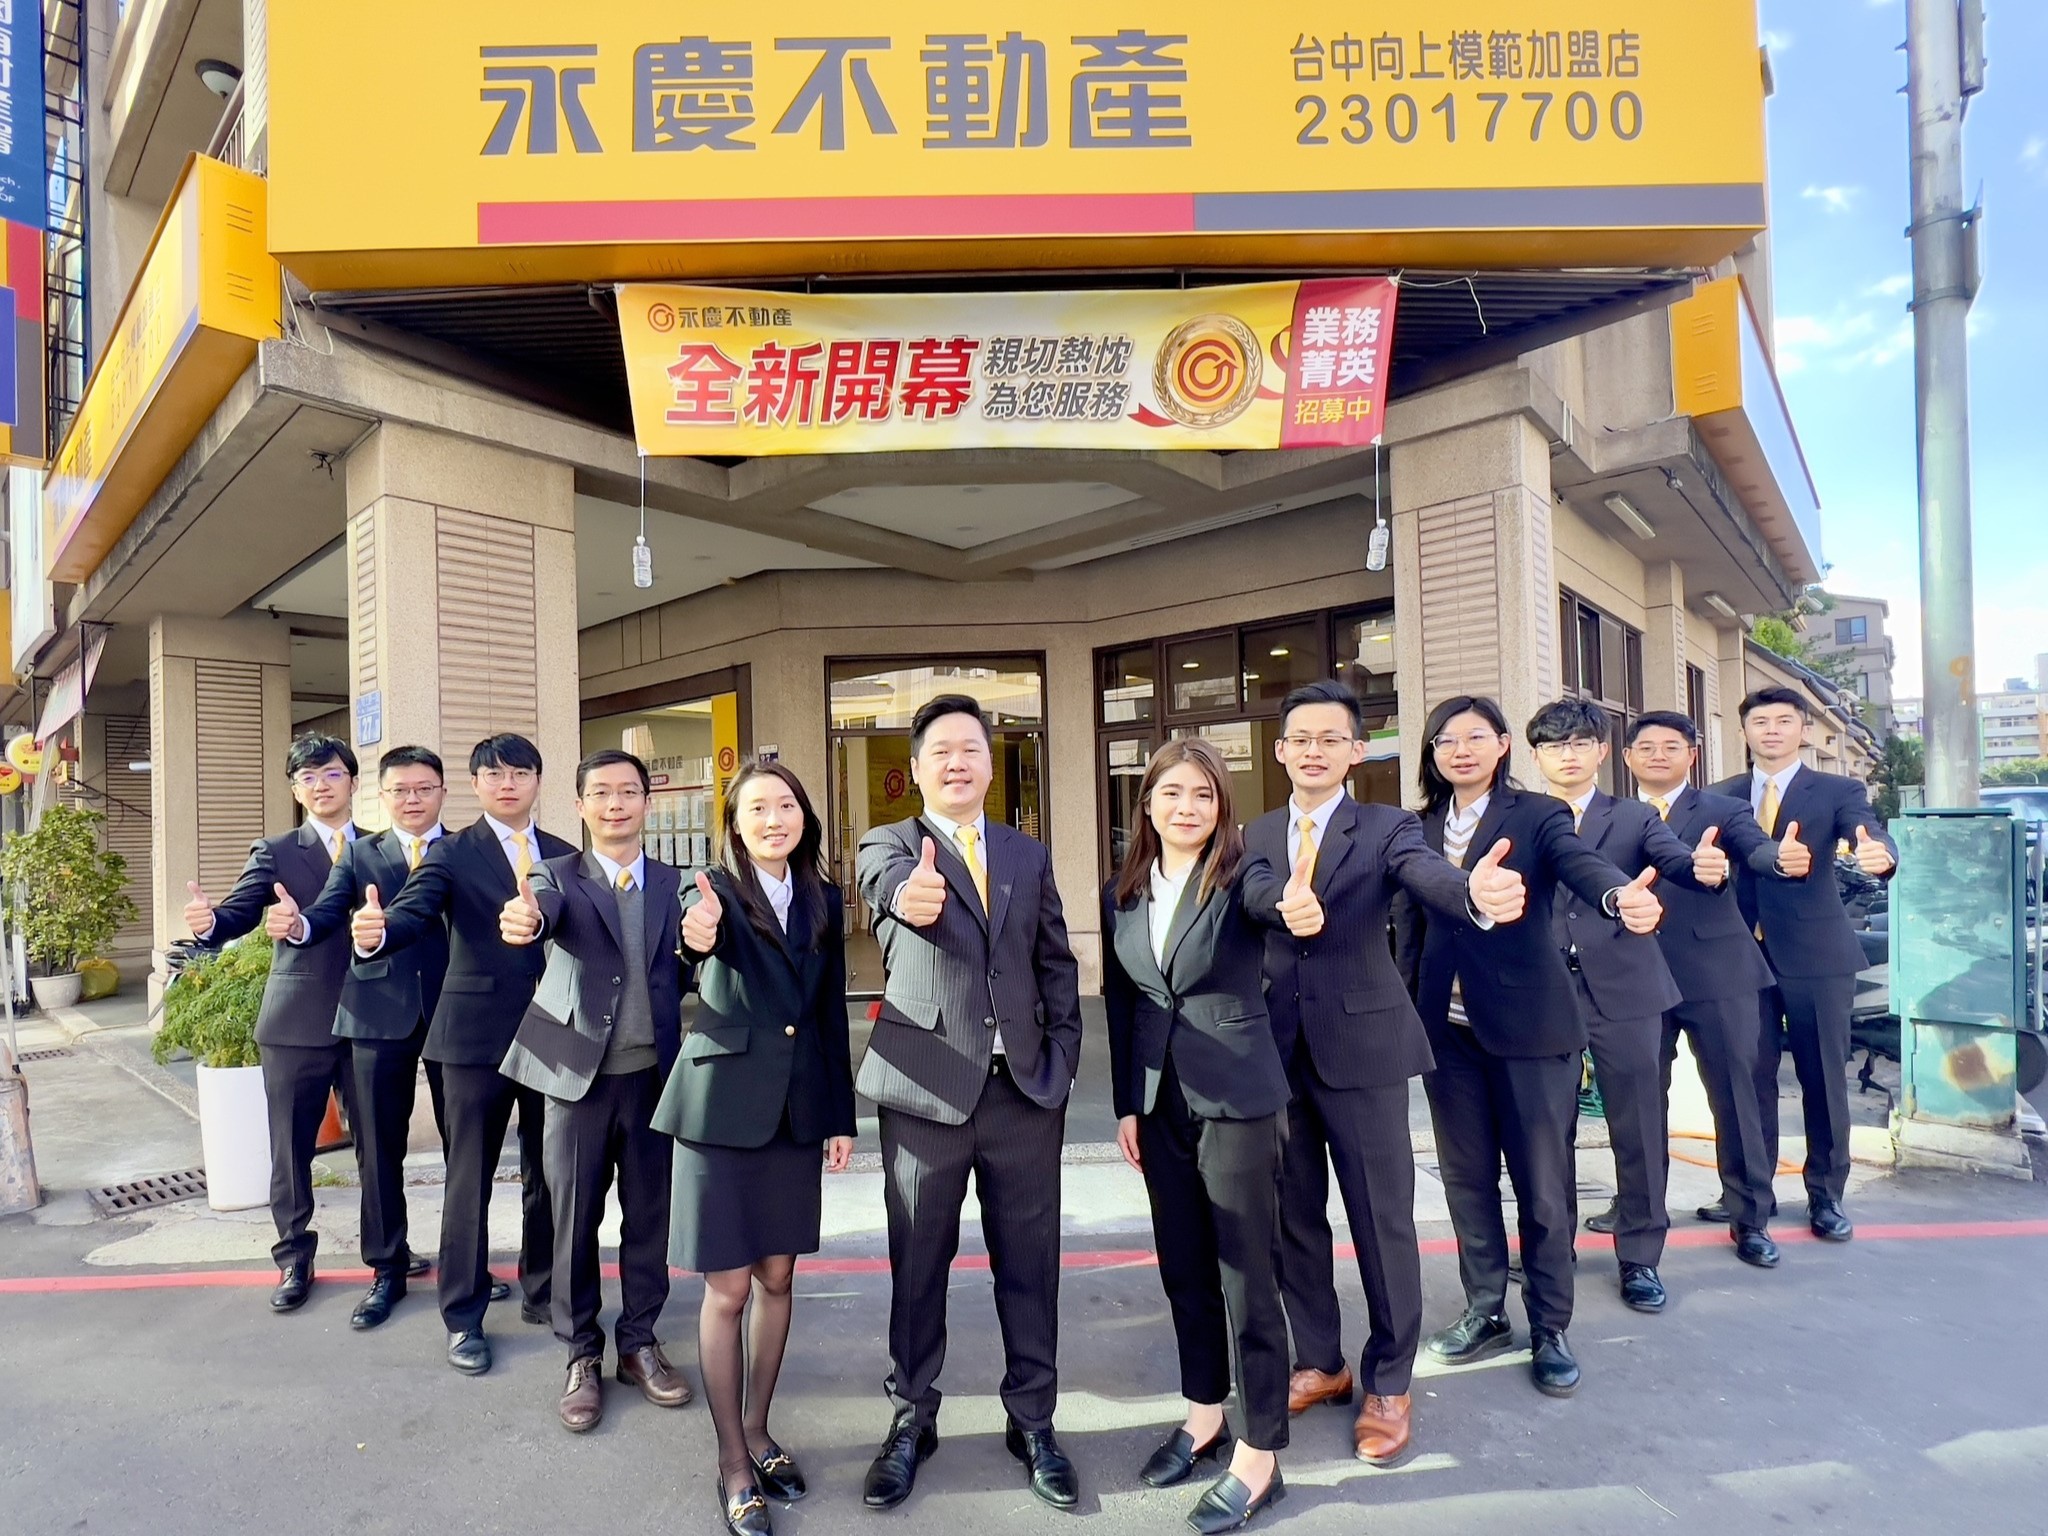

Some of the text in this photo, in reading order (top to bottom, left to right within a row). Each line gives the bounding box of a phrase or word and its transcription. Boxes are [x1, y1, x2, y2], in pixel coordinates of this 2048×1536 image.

[1290, 29, 1641, 83] 台中向上模範加盟店
[479, 29, 1192, 156] 永慶不動產
[1295, 90, 1644, 145] 23017700
[678, 306, 793, 328] 永慶不動產
[1303, 305, 1382, 348] 業務
[984, 335, 1131, 376] 親切熱忱
[1299, 347, 1377, 389] 菁英
[666, 336, 980, 424] 全新開幕
[984, 381, 1129, 420] 為您服務
[1294, 396, 1372, 425] 招募中
